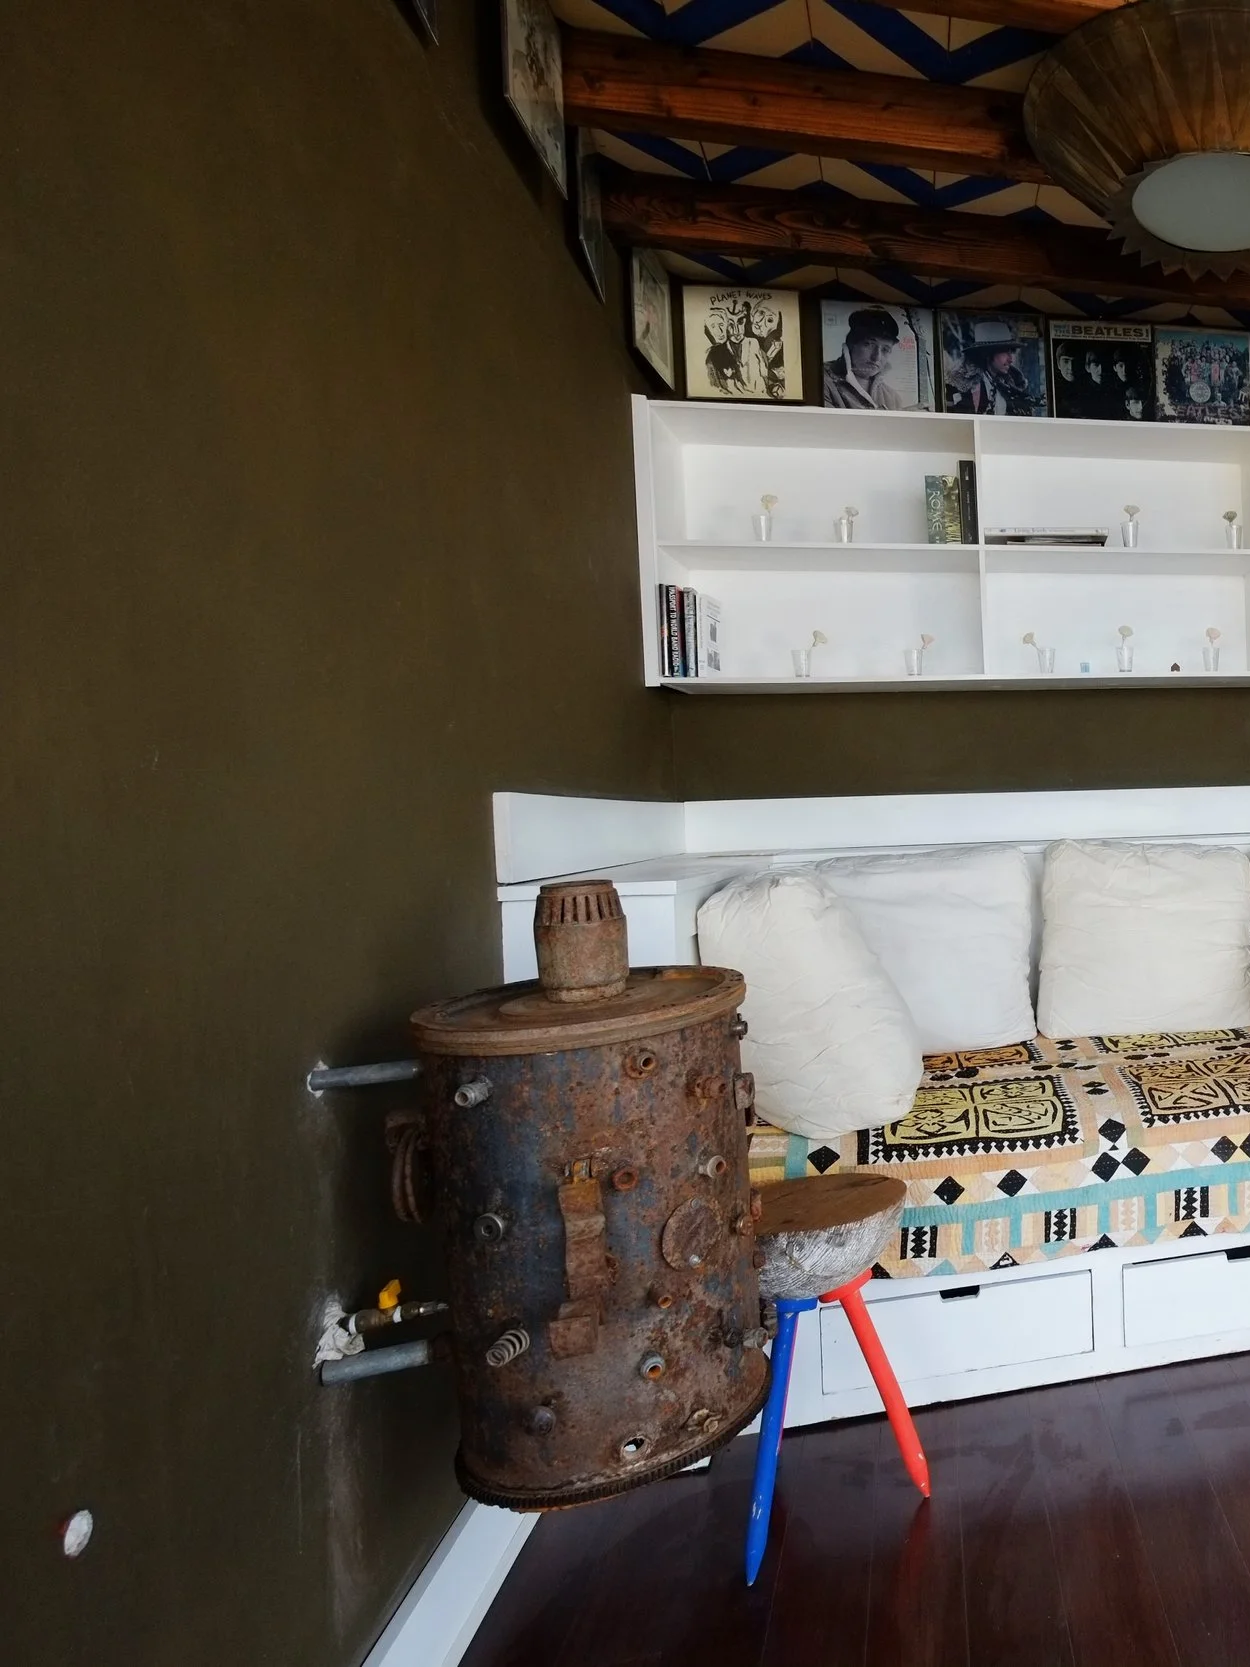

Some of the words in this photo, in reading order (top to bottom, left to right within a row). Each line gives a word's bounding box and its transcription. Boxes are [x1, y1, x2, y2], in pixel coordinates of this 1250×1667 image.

[710, 291, 741, 305] PLANET
[746, 291, 772, 300] WAVES
[1071, 325, 1149, 337] BEATLES!
[929, 490, 943, 531] ROME
[670, 619, 679, 636] WORLD
[671, 637, 680, 651] BAND
